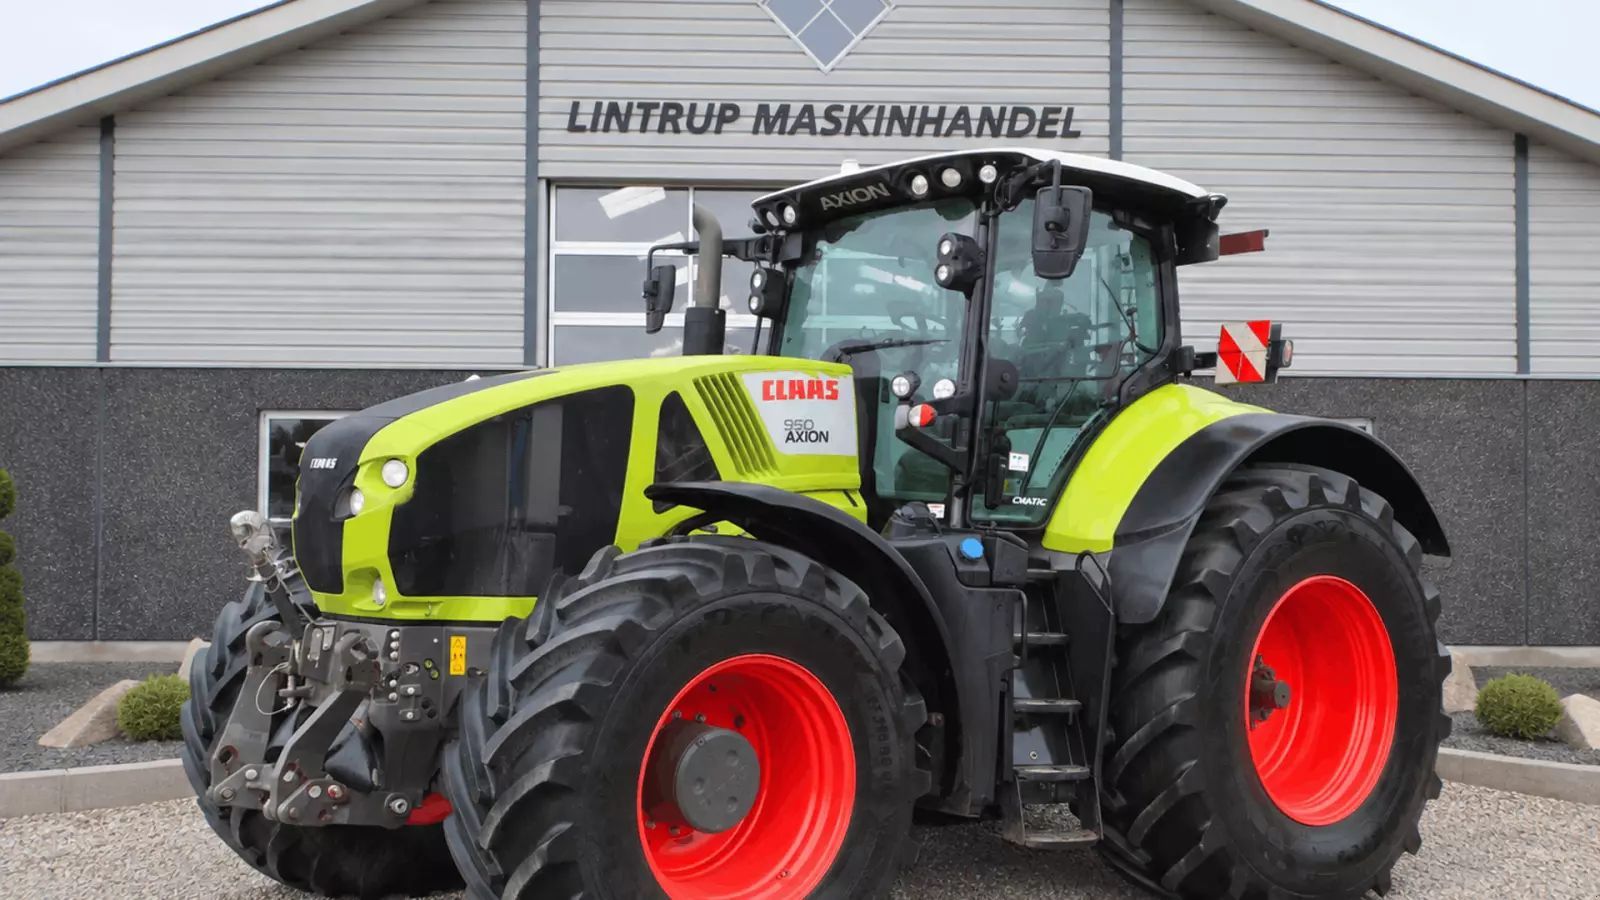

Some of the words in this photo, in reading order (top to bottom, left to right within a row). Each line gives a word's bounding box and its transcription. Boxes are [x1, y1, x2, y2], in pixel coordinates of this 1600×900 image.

[567, 100, 740, 134] LINTRUP
[752, 103, 1082, 138] MASKINHANDEL
[820, 182, 891, 211] AXION
[762, 379, 839, 401] CLAAS
[784, 419, 815, 431] 950
[785, 430, 829, 443] AXION
